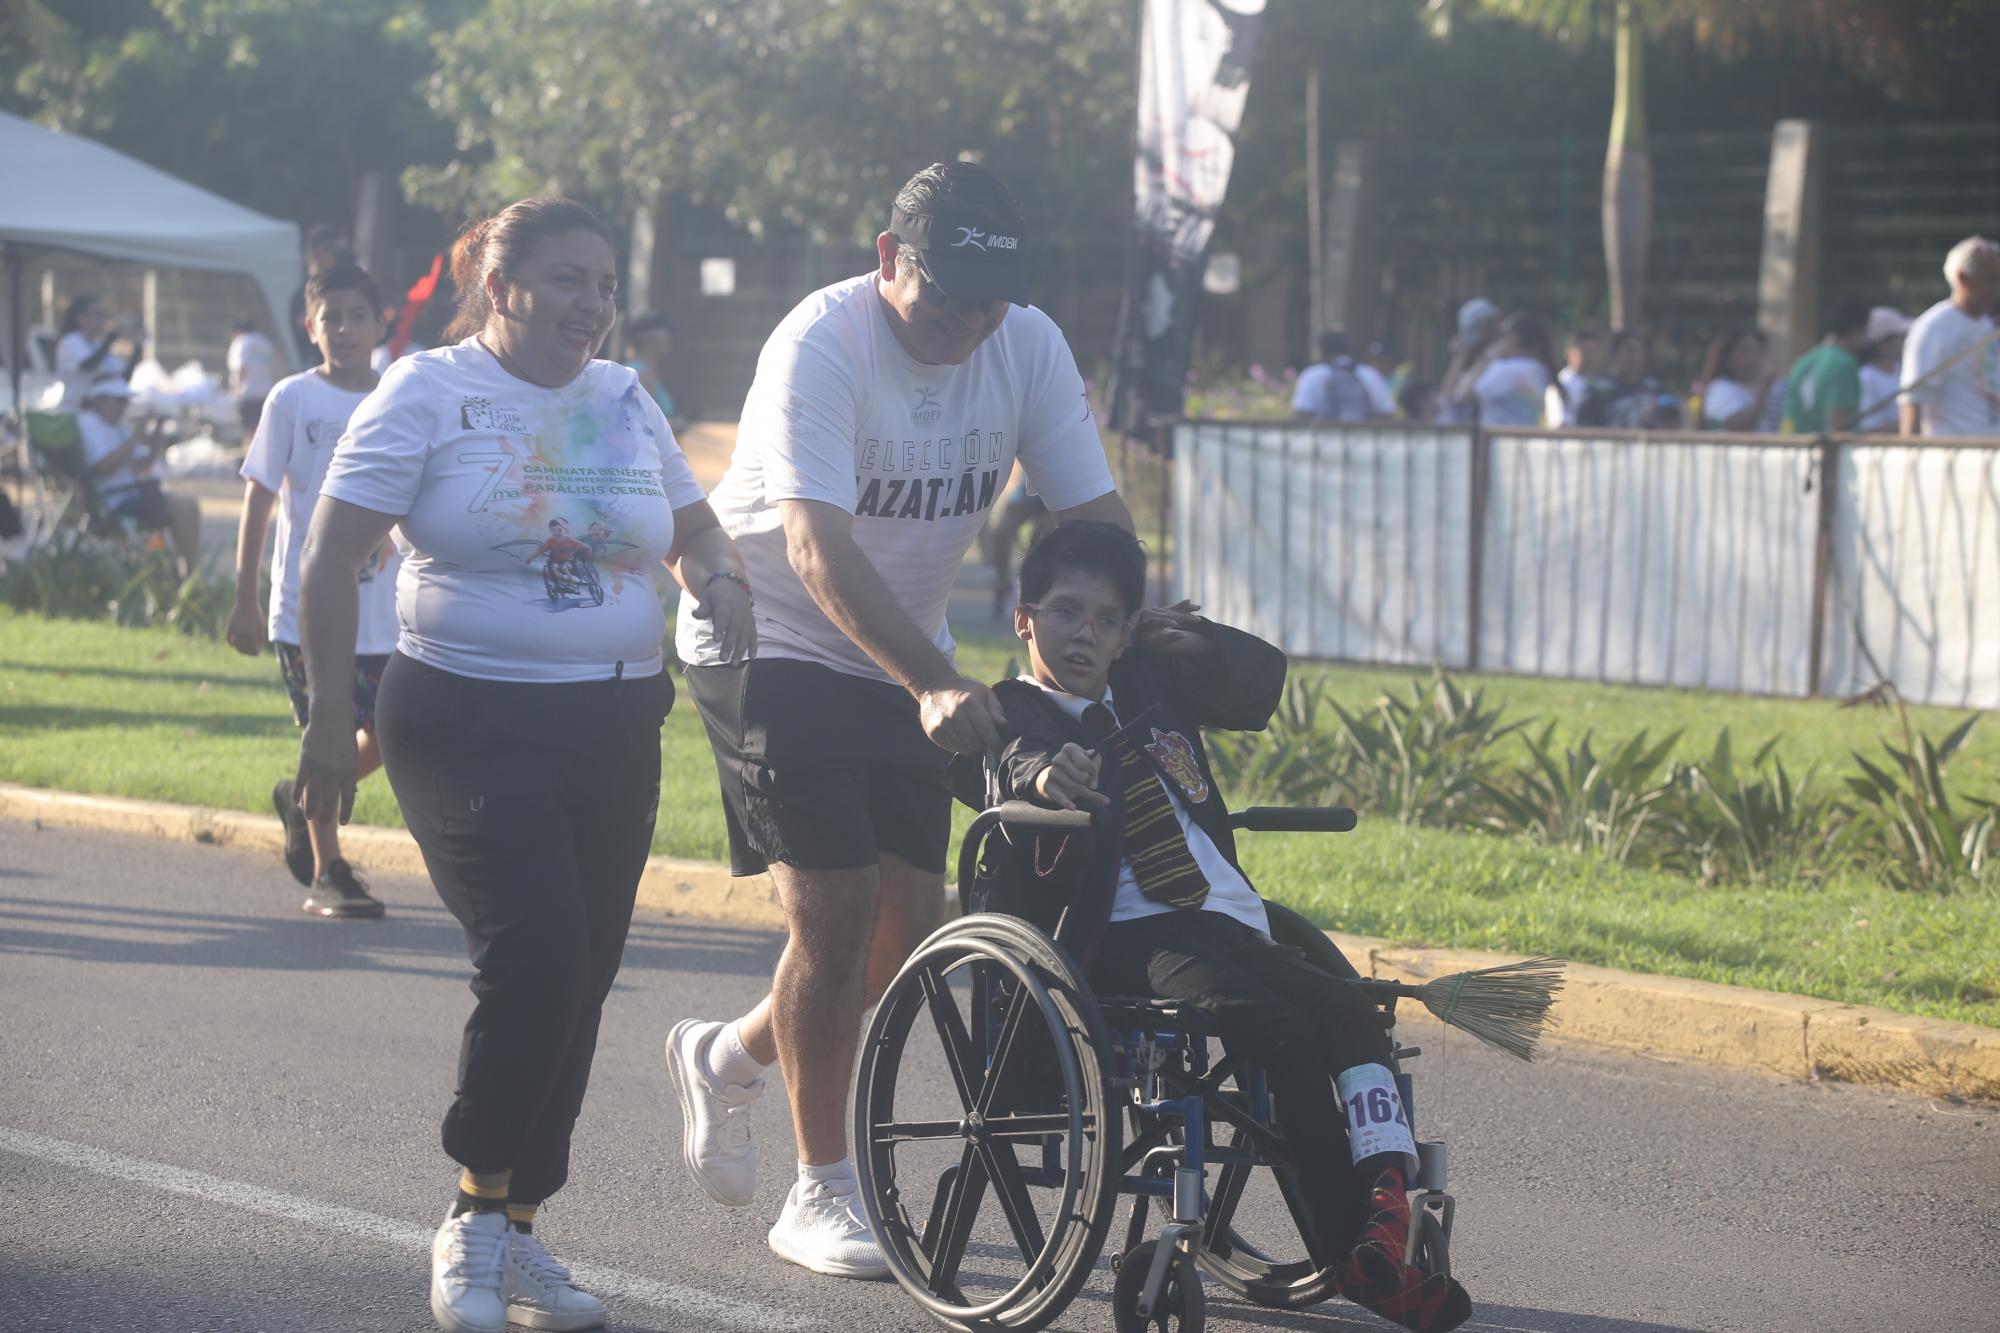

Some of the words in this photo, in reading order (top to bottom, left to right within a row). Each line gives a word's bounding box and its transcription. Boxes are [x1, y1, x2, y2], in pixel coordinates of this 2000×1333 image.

[523, 465, 596, 475] CAMINATA
[854, 429, 1003, 472] ELECCÓN
[855, 467, 998, 521] AZATLÁN
